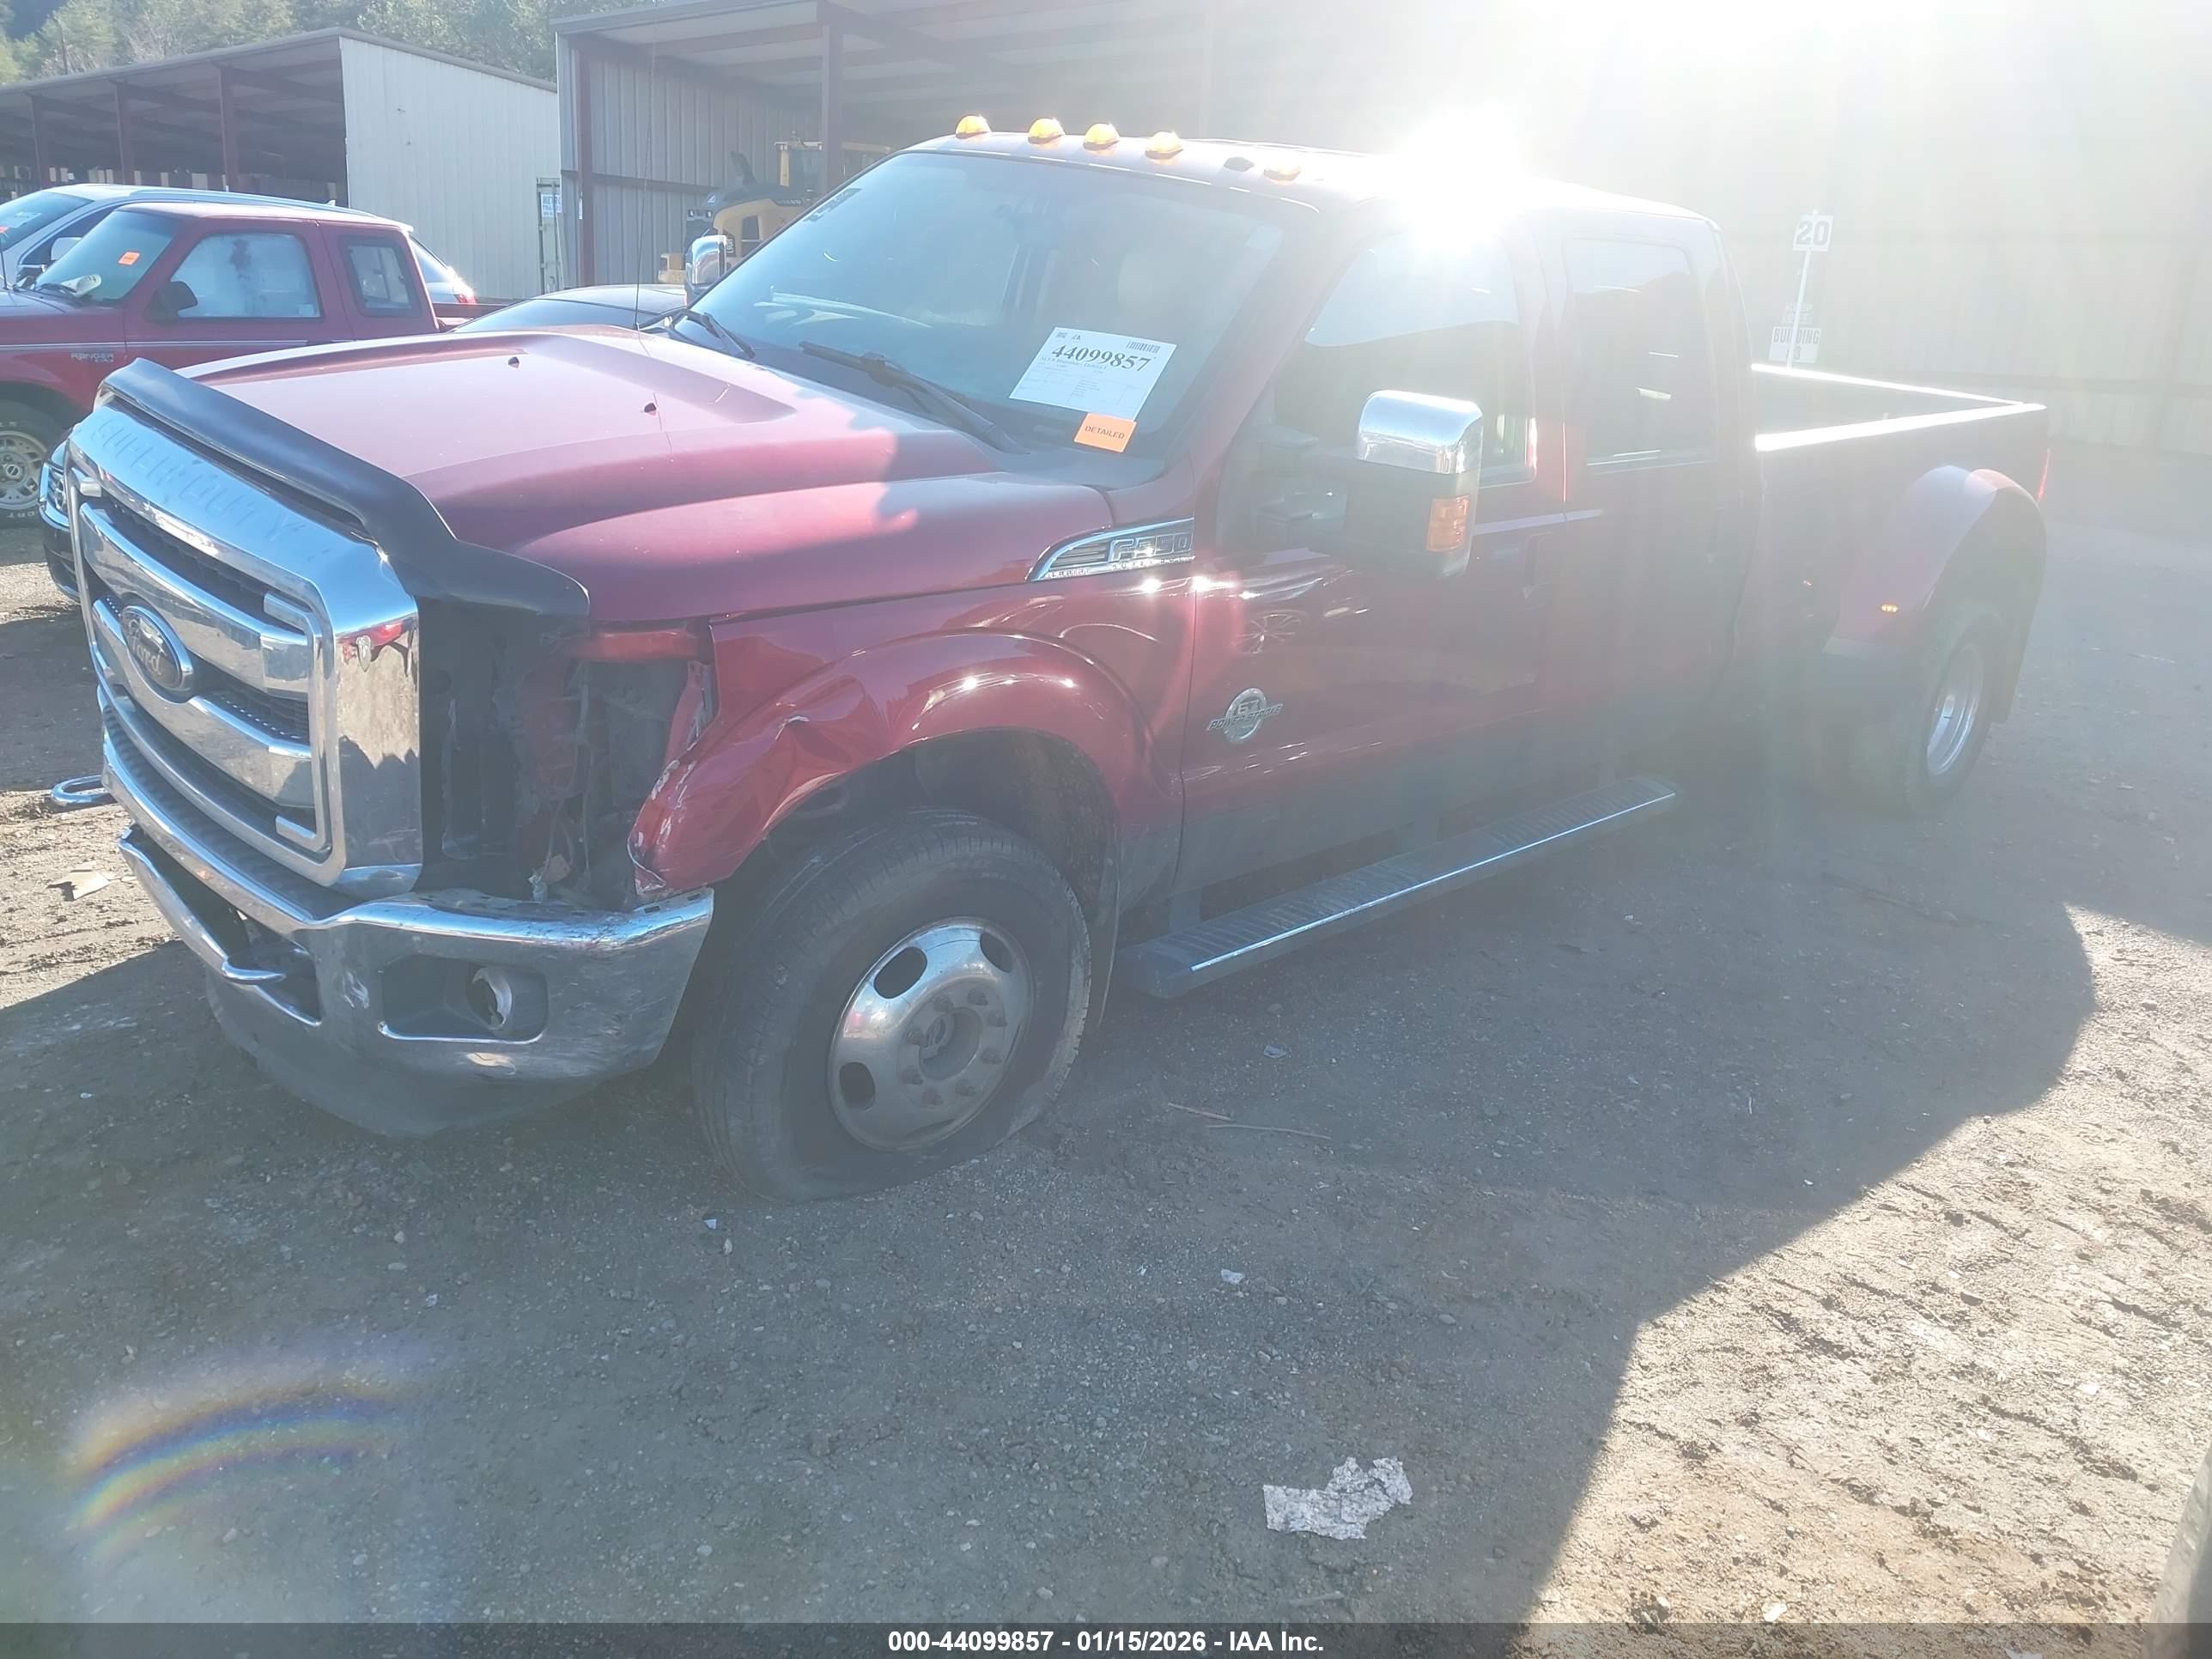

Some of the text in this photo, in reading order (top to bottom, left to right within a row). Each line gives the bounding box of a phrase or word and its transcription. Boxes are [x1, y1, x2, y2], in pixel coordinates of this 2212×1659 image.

[1796, 221, 1830, 246] 20
[1052, 343, 1152, 372] 44099857
[1085, 425, 1126, 440] DETAILED
